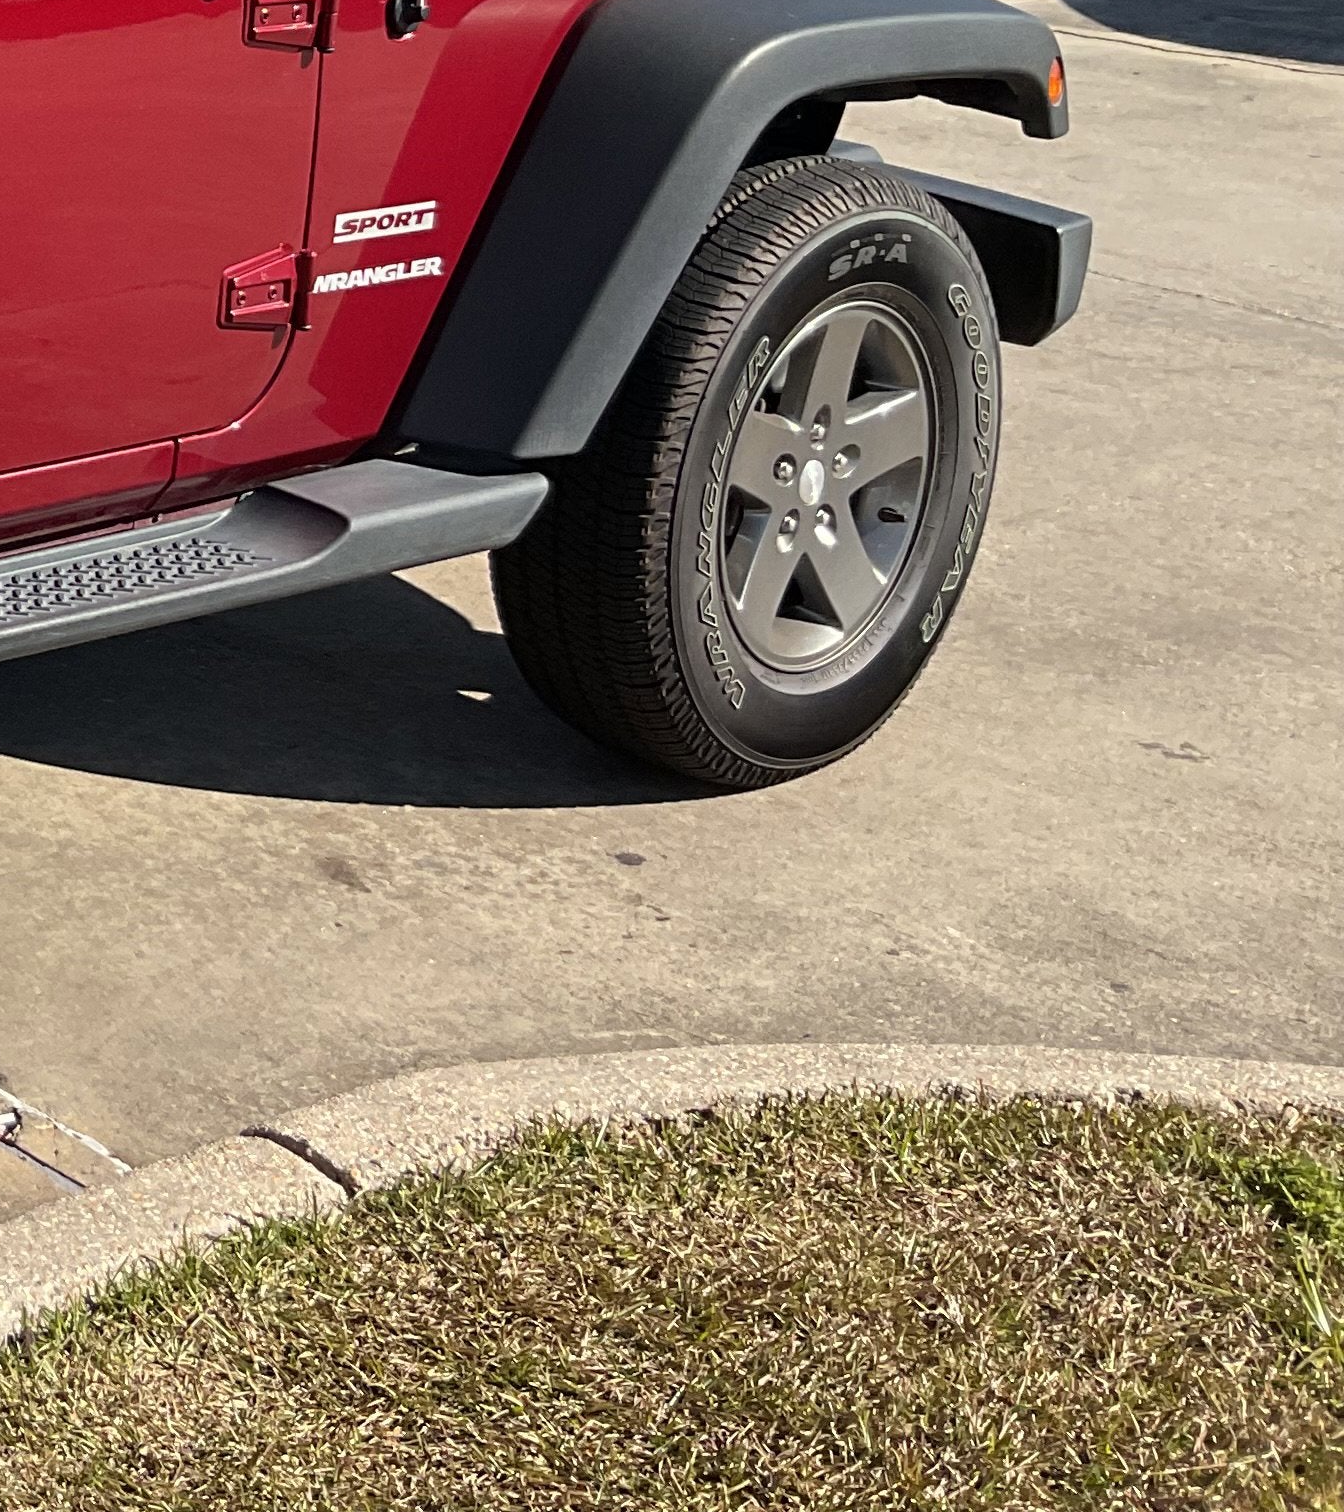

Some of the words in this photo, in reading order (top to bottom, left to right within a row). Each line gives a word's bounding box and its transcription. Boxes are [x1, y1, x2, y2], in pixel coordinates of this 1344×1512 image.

[334, 207, 435, 237] SPORT
[696, 336, 771, 709] WRANGLER
[920, 283, 996, 644] GOODYEAR
